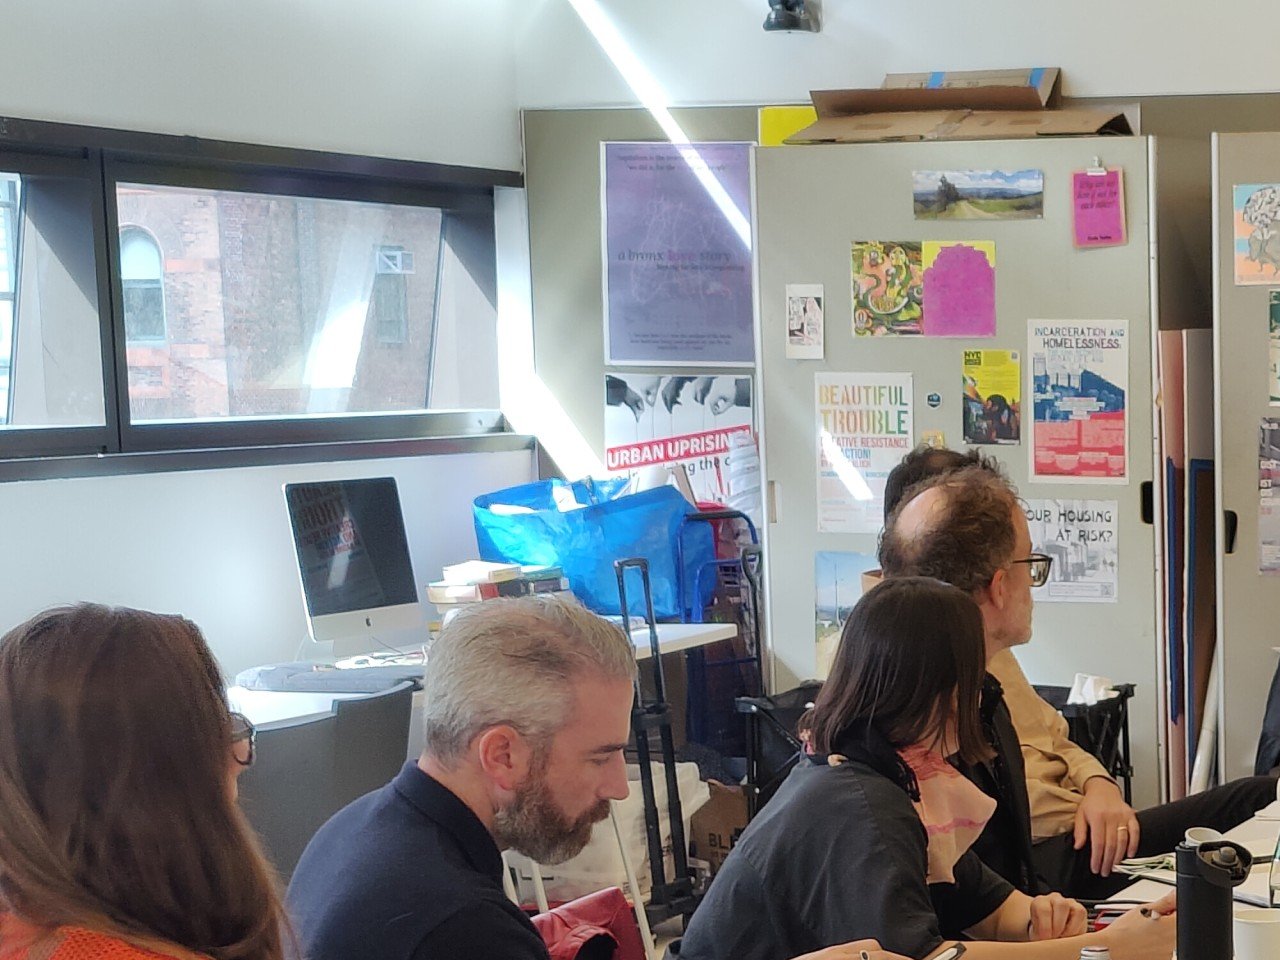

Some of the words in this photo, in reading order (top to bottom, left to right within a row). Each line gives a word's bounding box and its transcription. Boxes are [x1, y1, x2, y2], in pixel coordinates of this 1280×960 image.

[628, 249, 664, 262] bronx
[1035, 327, 1106, 337] INCARCERATION
[819, 385, 908, 406] BEAUTIFUL
[821, 410, 908, 434] TROUBLE
[607, 444, 665, 468] URBAN
[667, 431, 732, 458] UPRISIN
[861, 437, 908, 448] RESISTANCE
[1027, 509, 1051, 522] OUR
[1058, 510, 1112, 522] HOUSING
[1056, 529, 1071, 542] AT
[1078, 529, 1113, 545] RISK?
